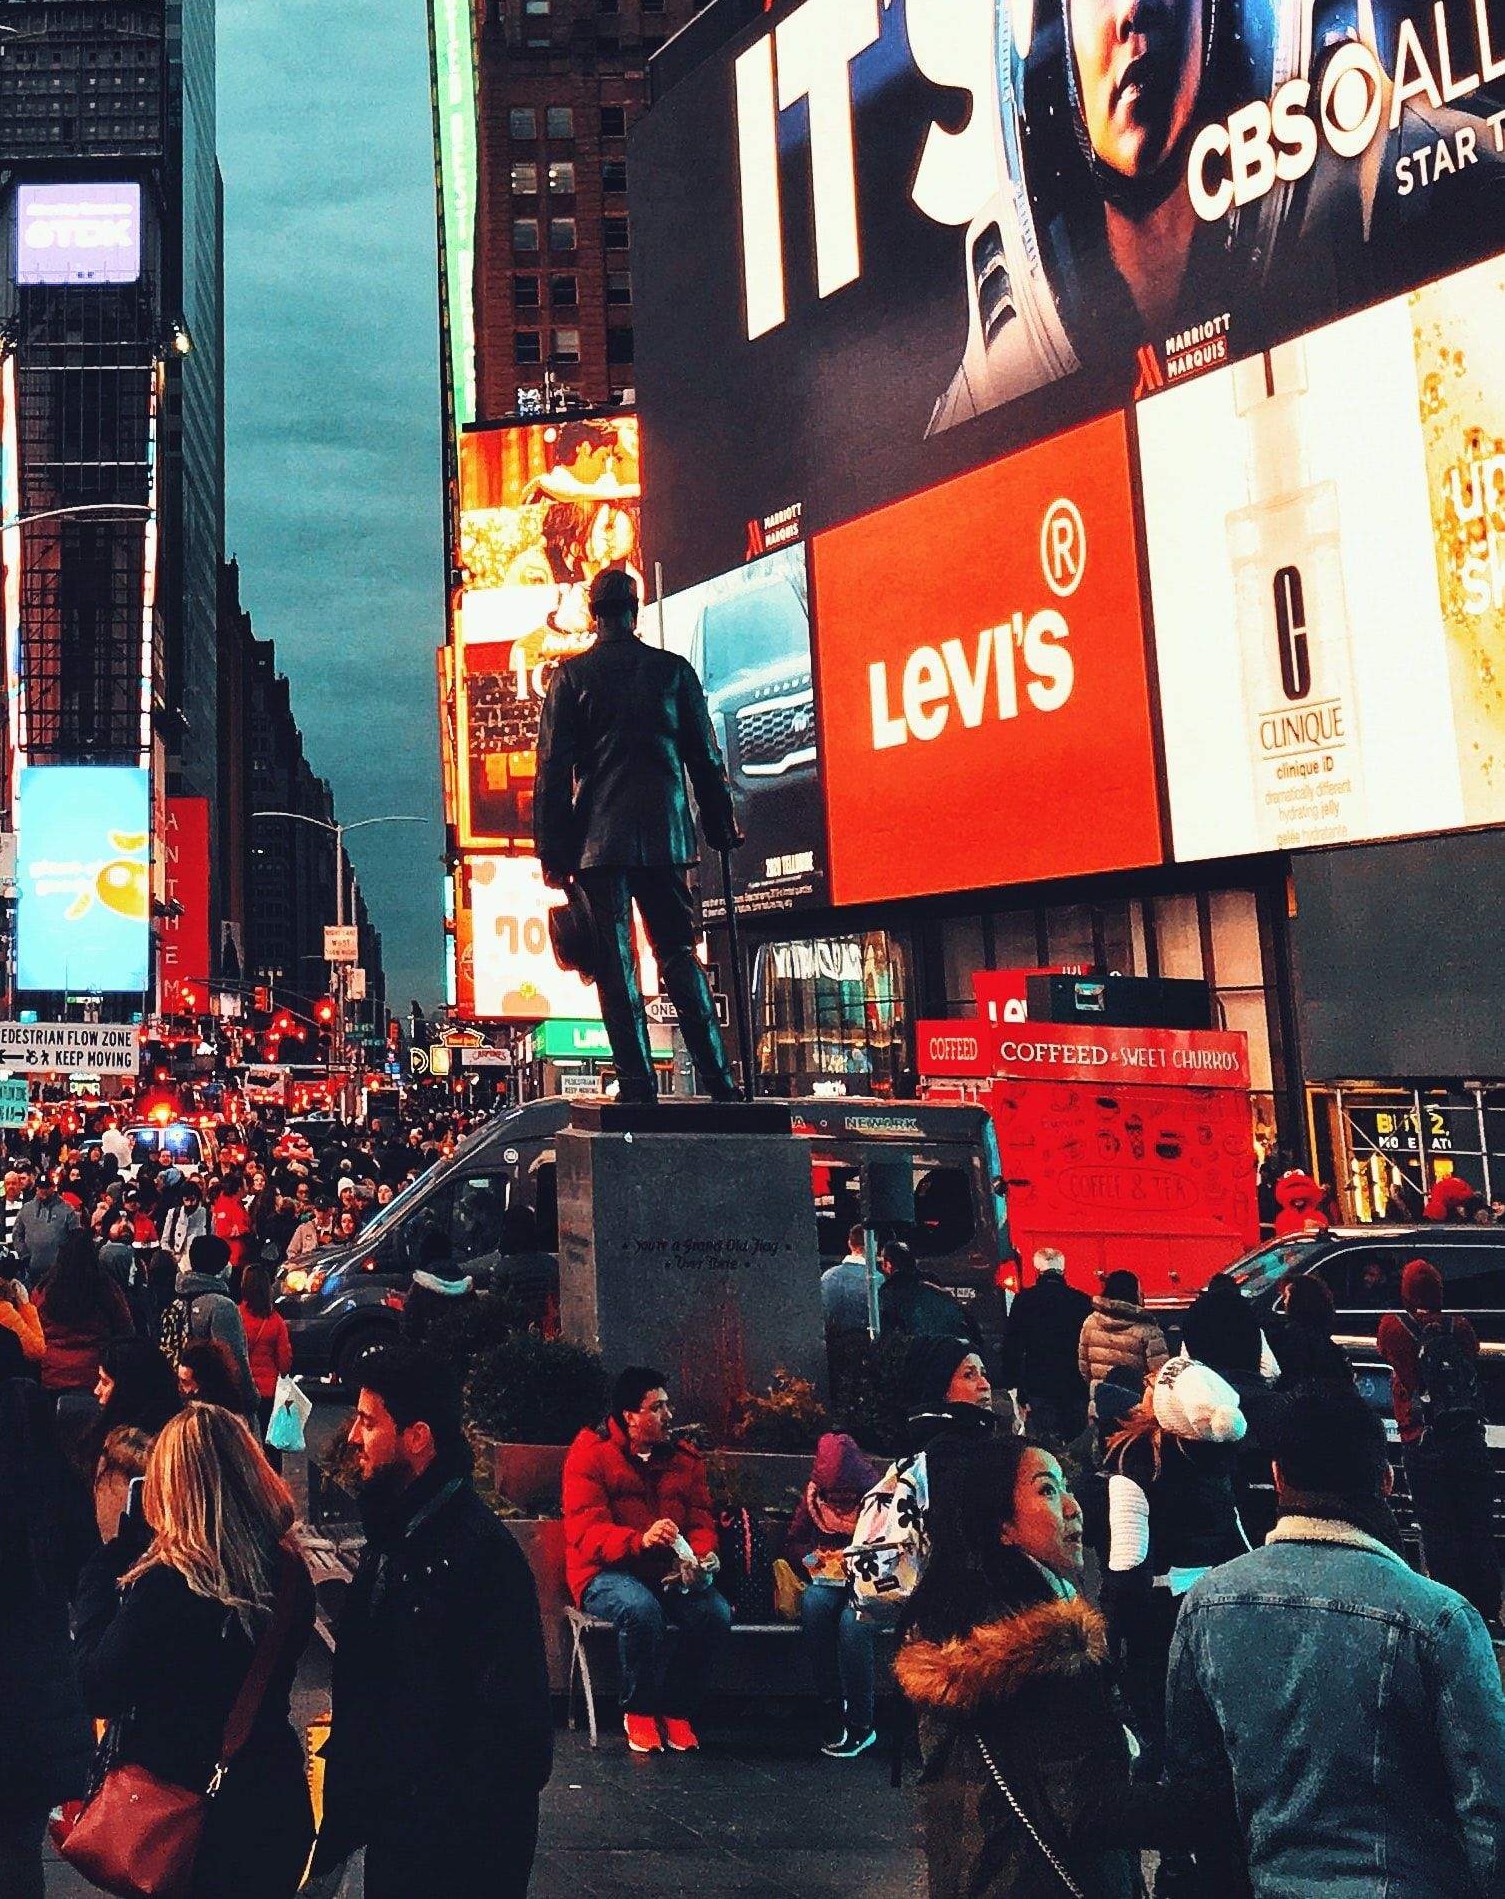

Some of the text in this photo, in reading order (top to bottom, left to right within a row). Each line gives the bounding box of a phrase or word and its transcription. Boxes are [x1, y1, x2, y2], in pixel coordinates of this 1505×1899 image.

[1187, 79, 1318, 223] CBS
[1394, 127, 1478, 198] STAR
[1165, 313, 1231, 356] MARRIOTT
[1167, 340, 1225, 379] MARQUIS
[763, 502, 802, 530] MARRIOTT
[765, 522, 799, 548] MARQUIS
[1259, 706, 1345, 751] CLINIQUE
[165, 813, 180, 997] ANTHEM
[651, 1004, 676, 1018] ONE
[67, 1031, 98, 1046] FLOW
[101, 1032, 132, 1047] ZONE
[929, 1038, 978, 1060] COFFEED
[55, 1051, 132, 1068] KEEP MOVING
[1000, 1041, 1109, 1065] COFFEED
[1120, 1049, 1166, 1068] SWEET
[1172, 1050, 1240, 1071] CHURROS
[845, 1116, 919, 1130] NEWARK
